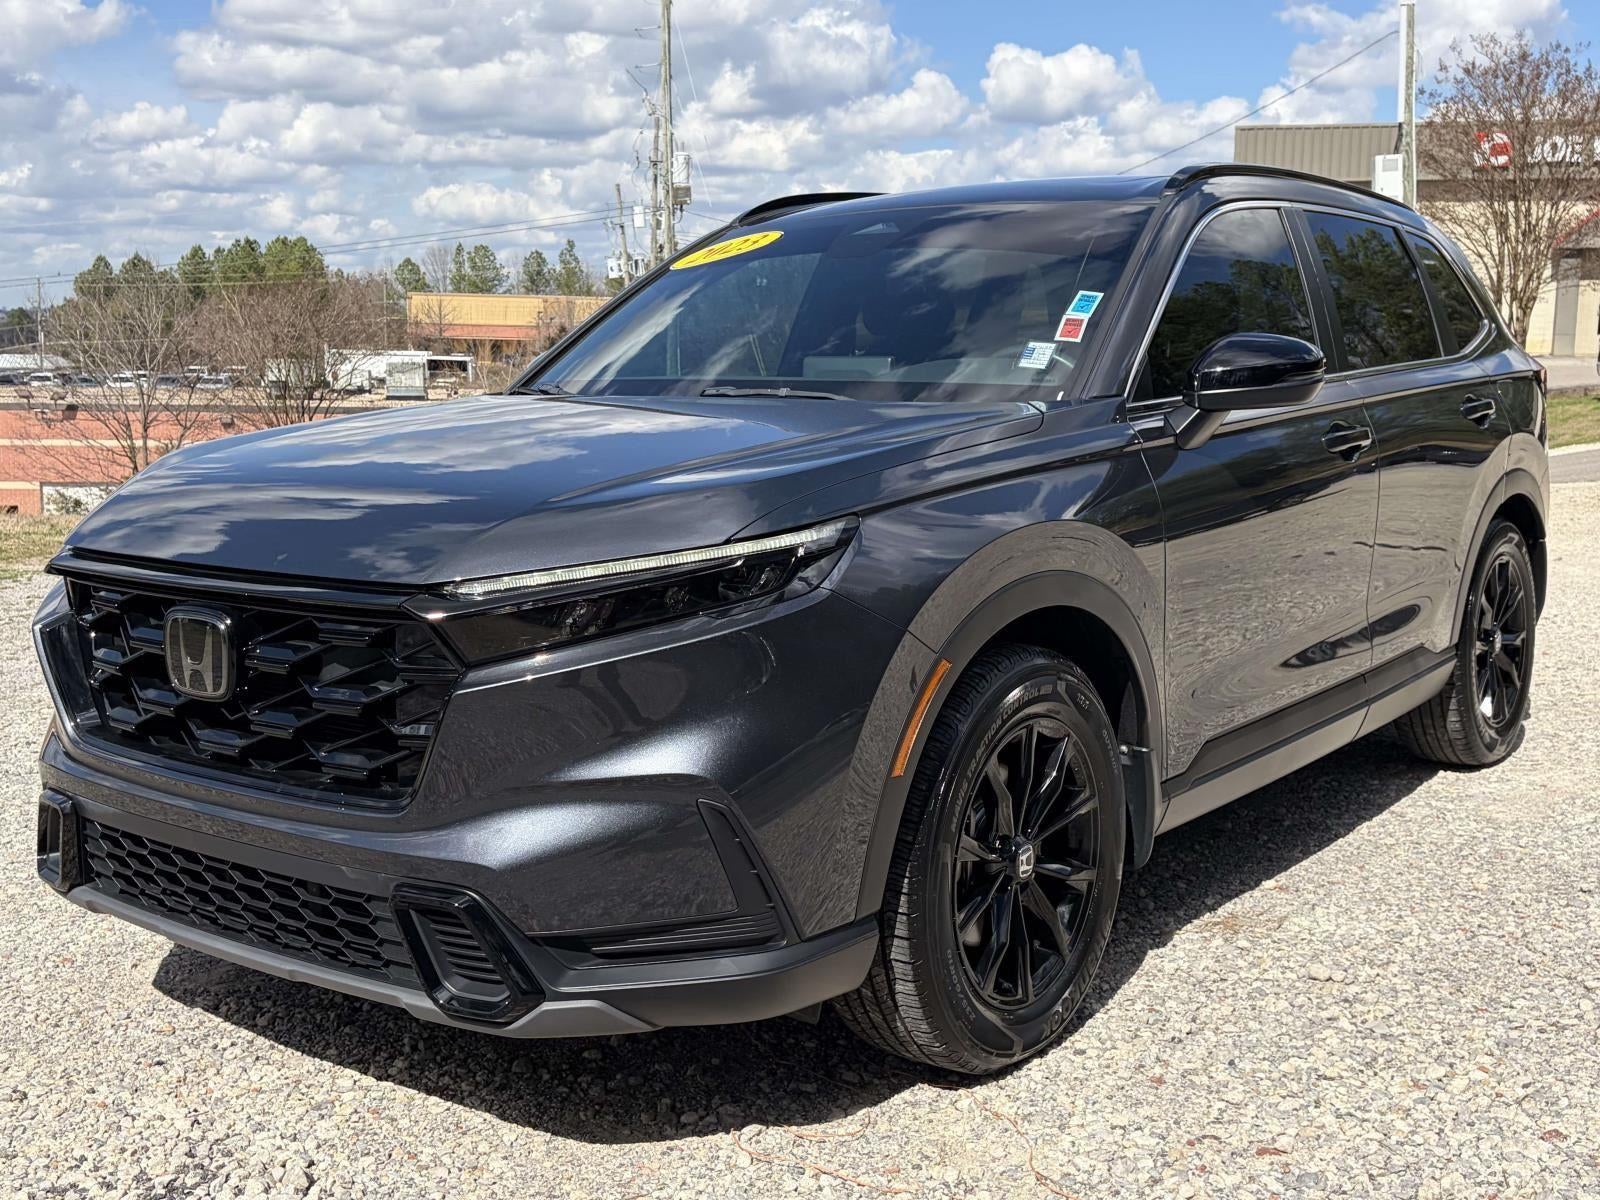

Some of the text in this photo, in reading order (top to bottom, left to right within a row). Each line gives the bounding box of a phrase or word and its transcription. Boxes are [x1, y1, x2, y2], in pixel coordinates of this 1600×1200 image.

[1527, 135, 1582, 163] JOE
[685, 234, 771, 263] 2023
[951, 688, 1039, 833] MAVIS TRACTION CONTROL
